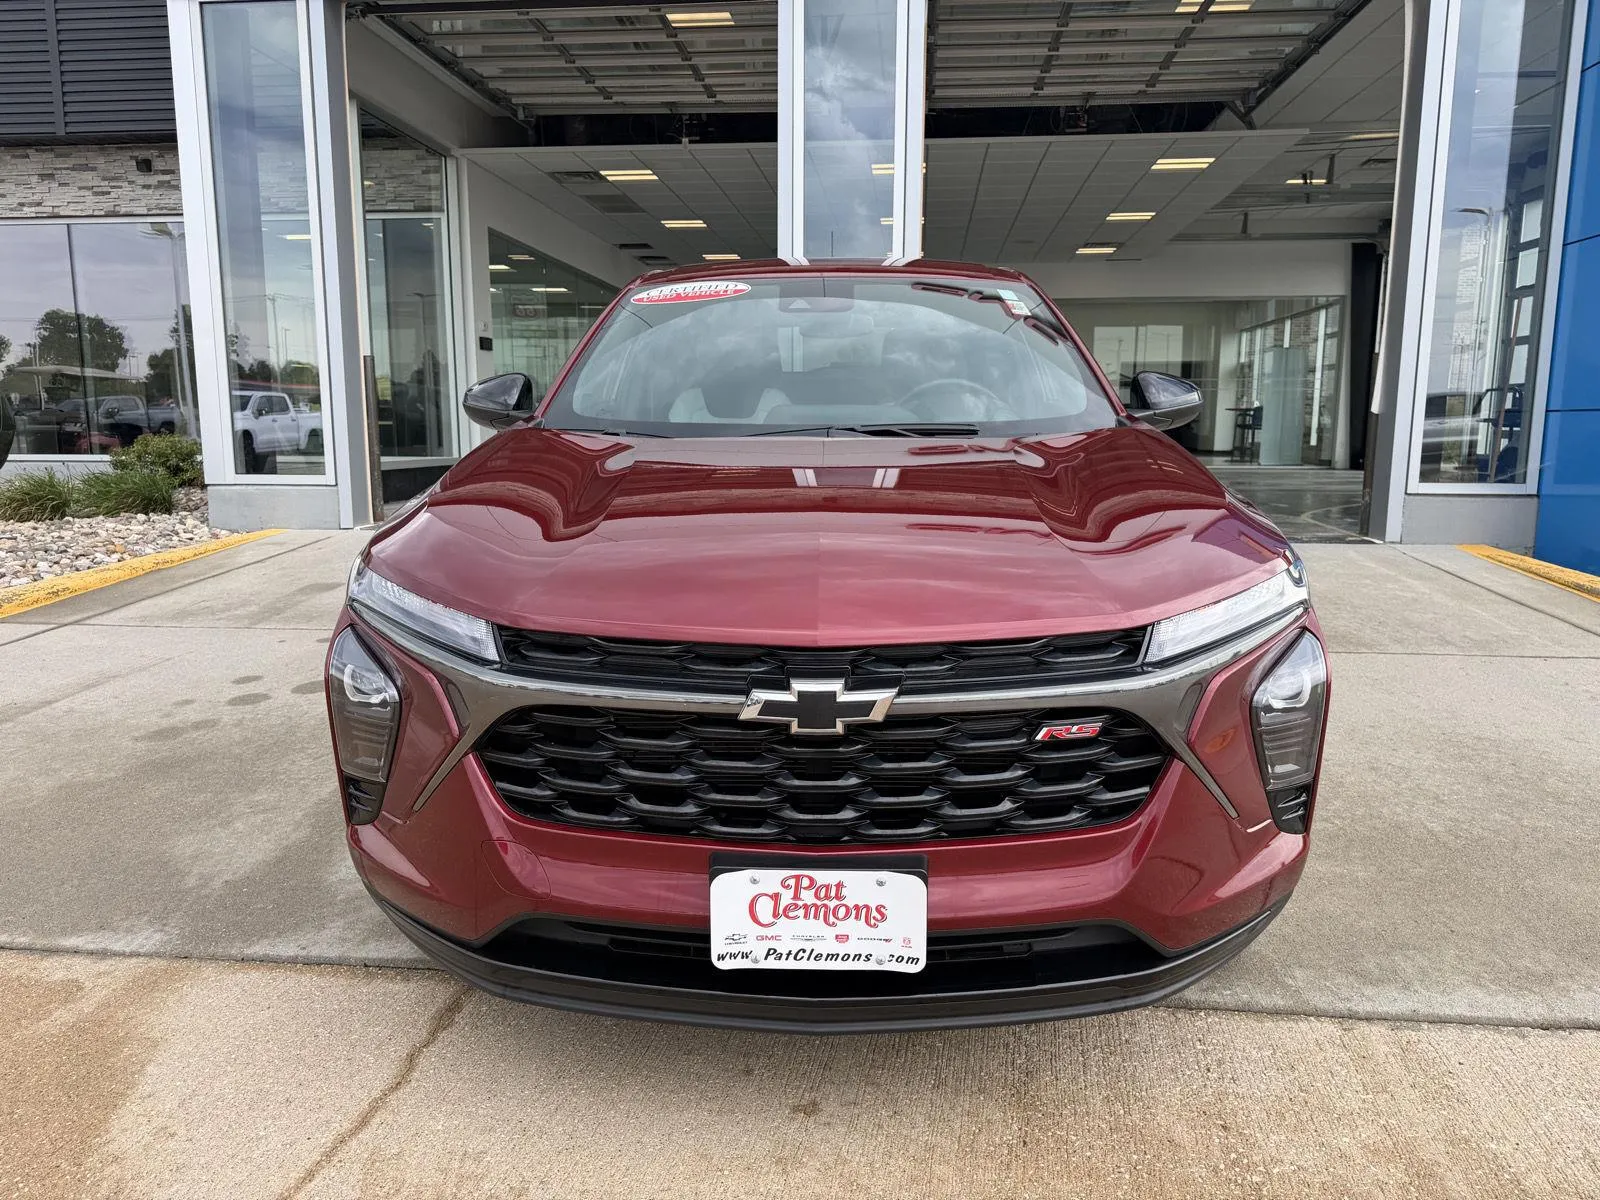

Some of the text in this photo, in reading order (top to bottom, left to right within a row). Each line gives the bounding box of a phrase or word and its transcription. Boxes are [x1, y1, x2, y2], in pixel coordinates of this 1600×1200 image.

[643, 289, 735, 302] USED VEHICLE
[1035, 722, 1103, 740] RS
[780, 873, 847, 902] Pat
[748, 892, 888, 928] Clemons
